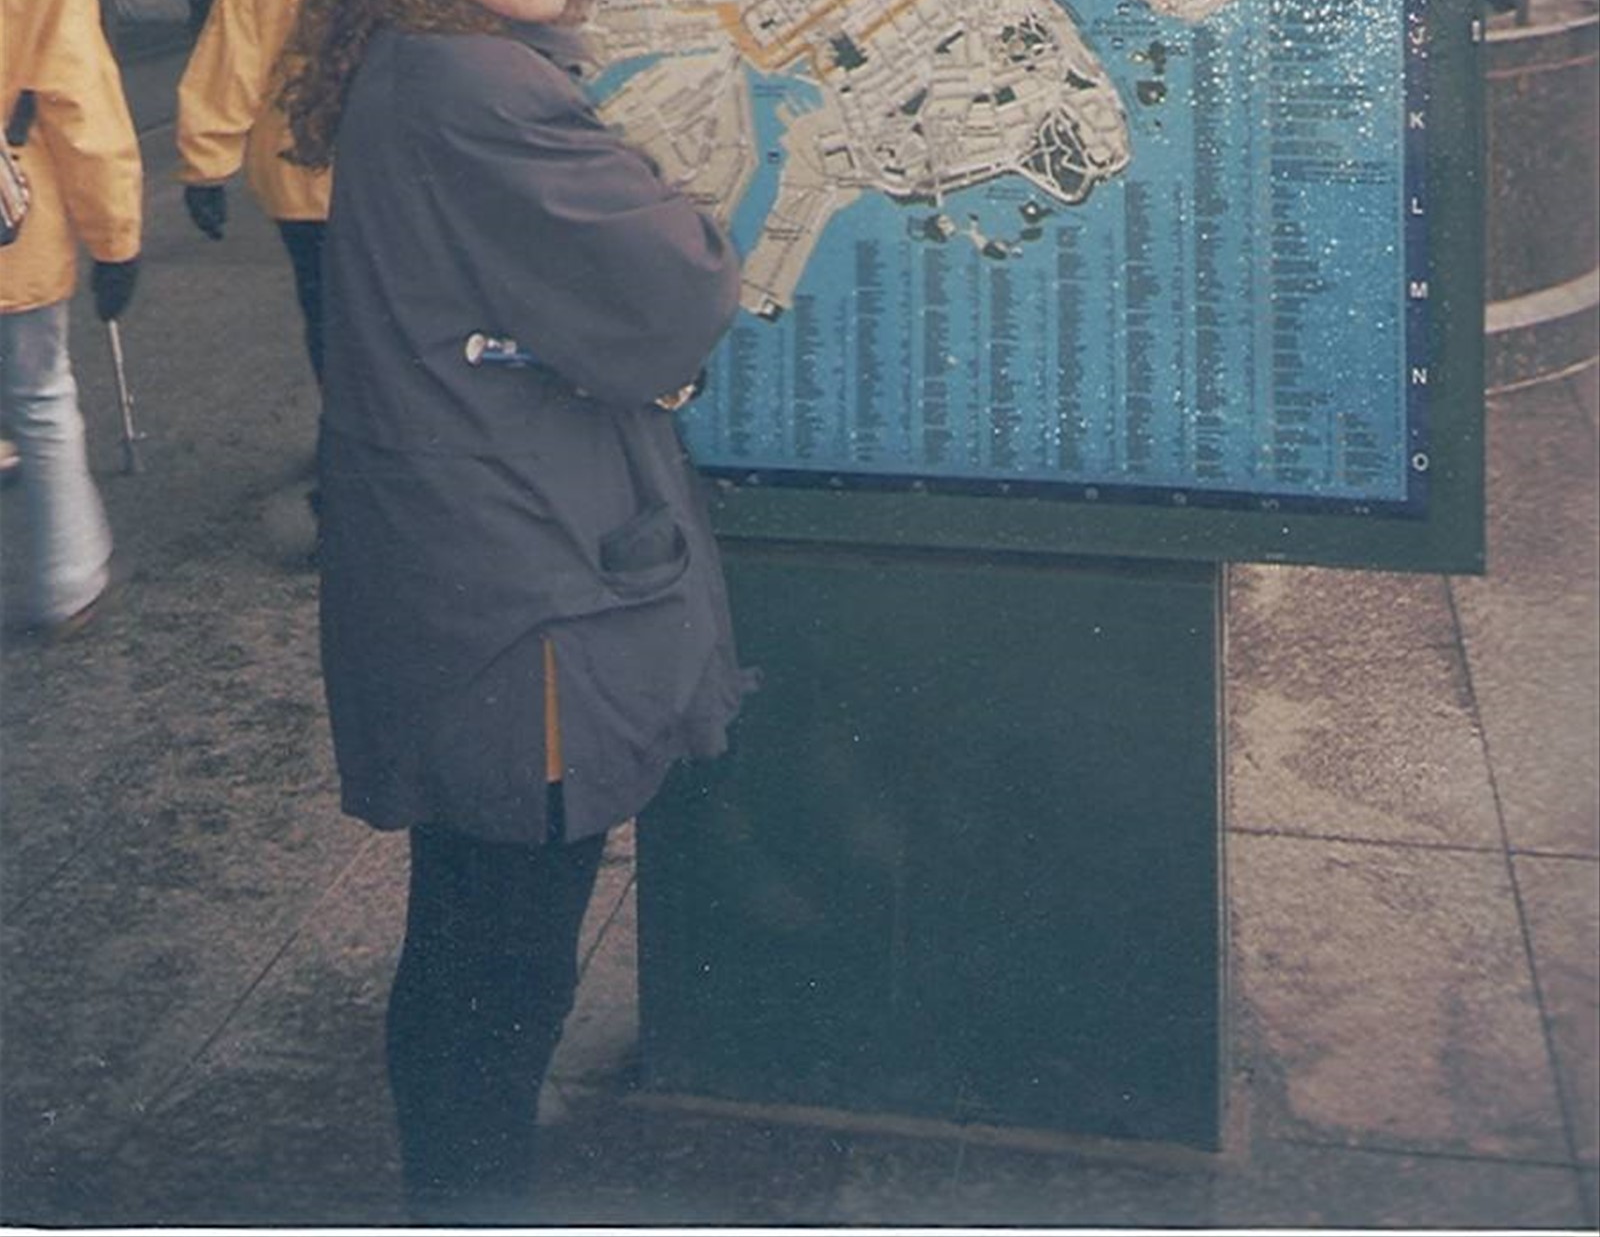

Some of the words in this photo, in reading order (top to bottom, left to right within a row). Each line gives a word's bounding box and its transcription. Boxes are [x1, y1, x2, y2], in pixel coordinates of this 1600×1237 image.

[1409, 111, 1426, 130] K
[1411, 197, 1424, 215] L
[1410, 281, 1429, 299] M
[1412, 368, 1428, 386] N
